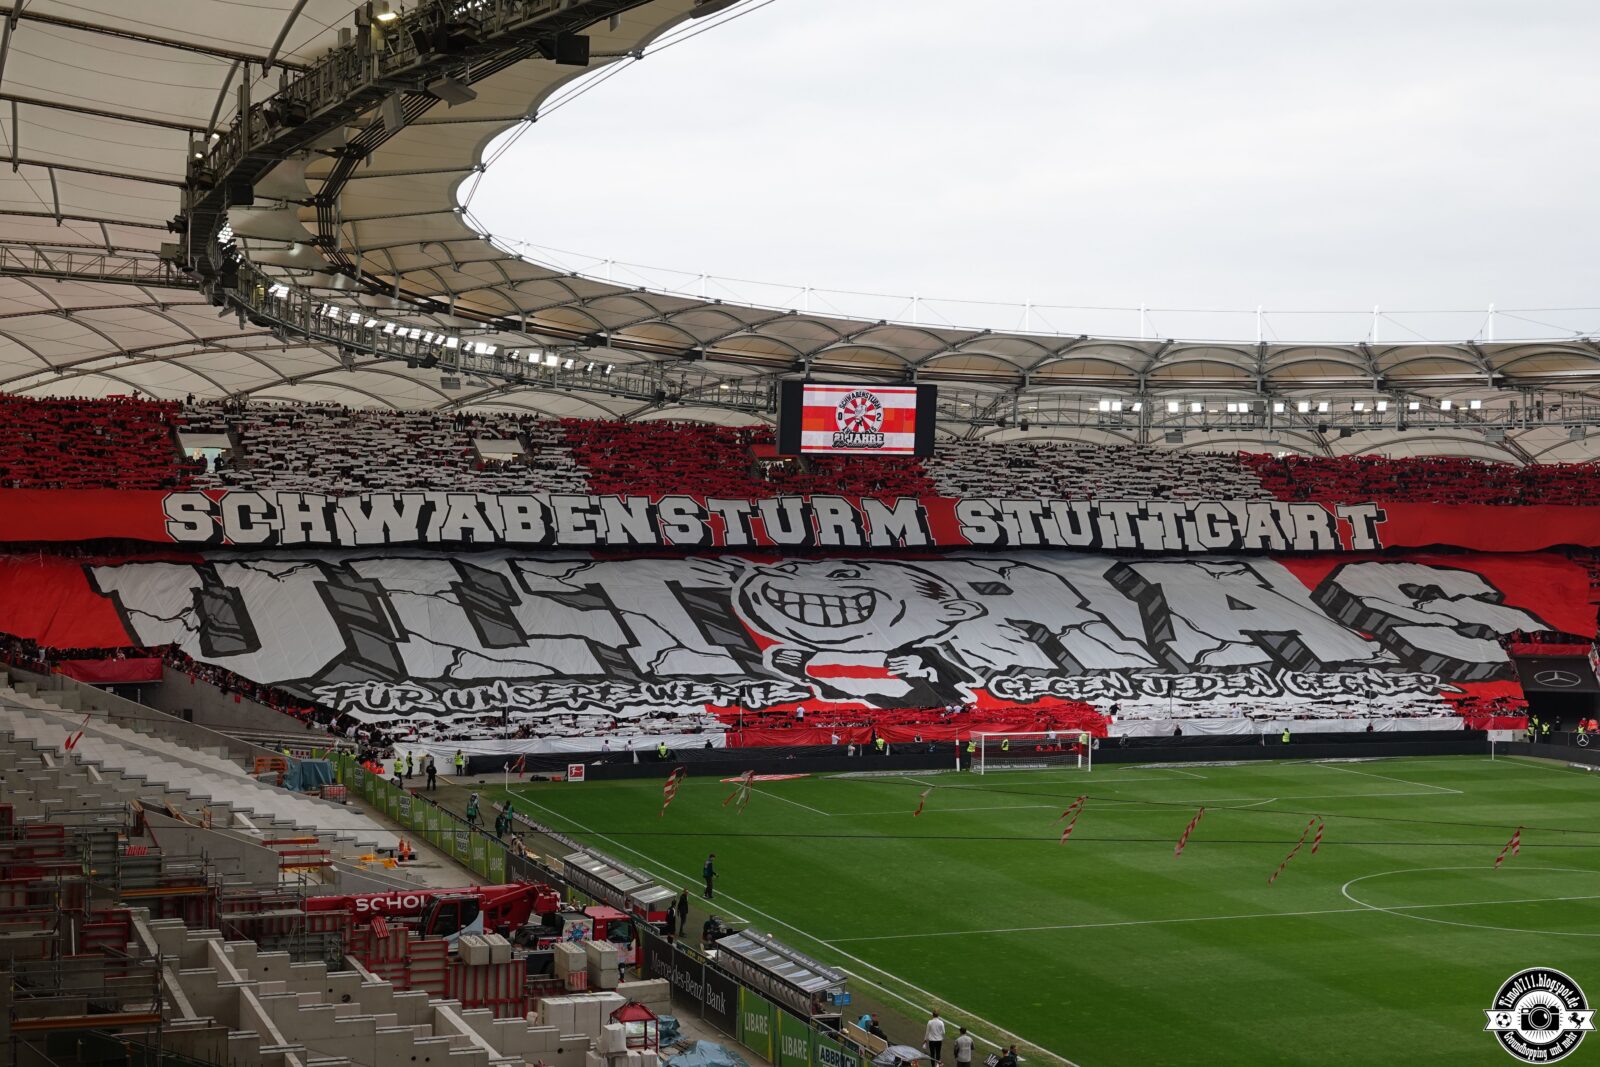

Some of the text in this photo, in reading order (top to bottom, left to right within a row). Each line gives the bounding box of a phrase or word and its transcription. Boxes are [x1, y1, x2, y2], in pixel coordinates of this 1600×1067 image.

[846, 433, 884, 444] JAHRE
[164, 493, 1387, 551] SCHWABENSTURM STUTTGART
[987, 671, 1134, 700] GEGEN
[1275, 667, 1463, 697] GEGNER
[706, 983, 726, 1015] Bank
[744, 1012, 768, 1035] LIBARE
[782, 1035, 808, 1060] LIBARE
